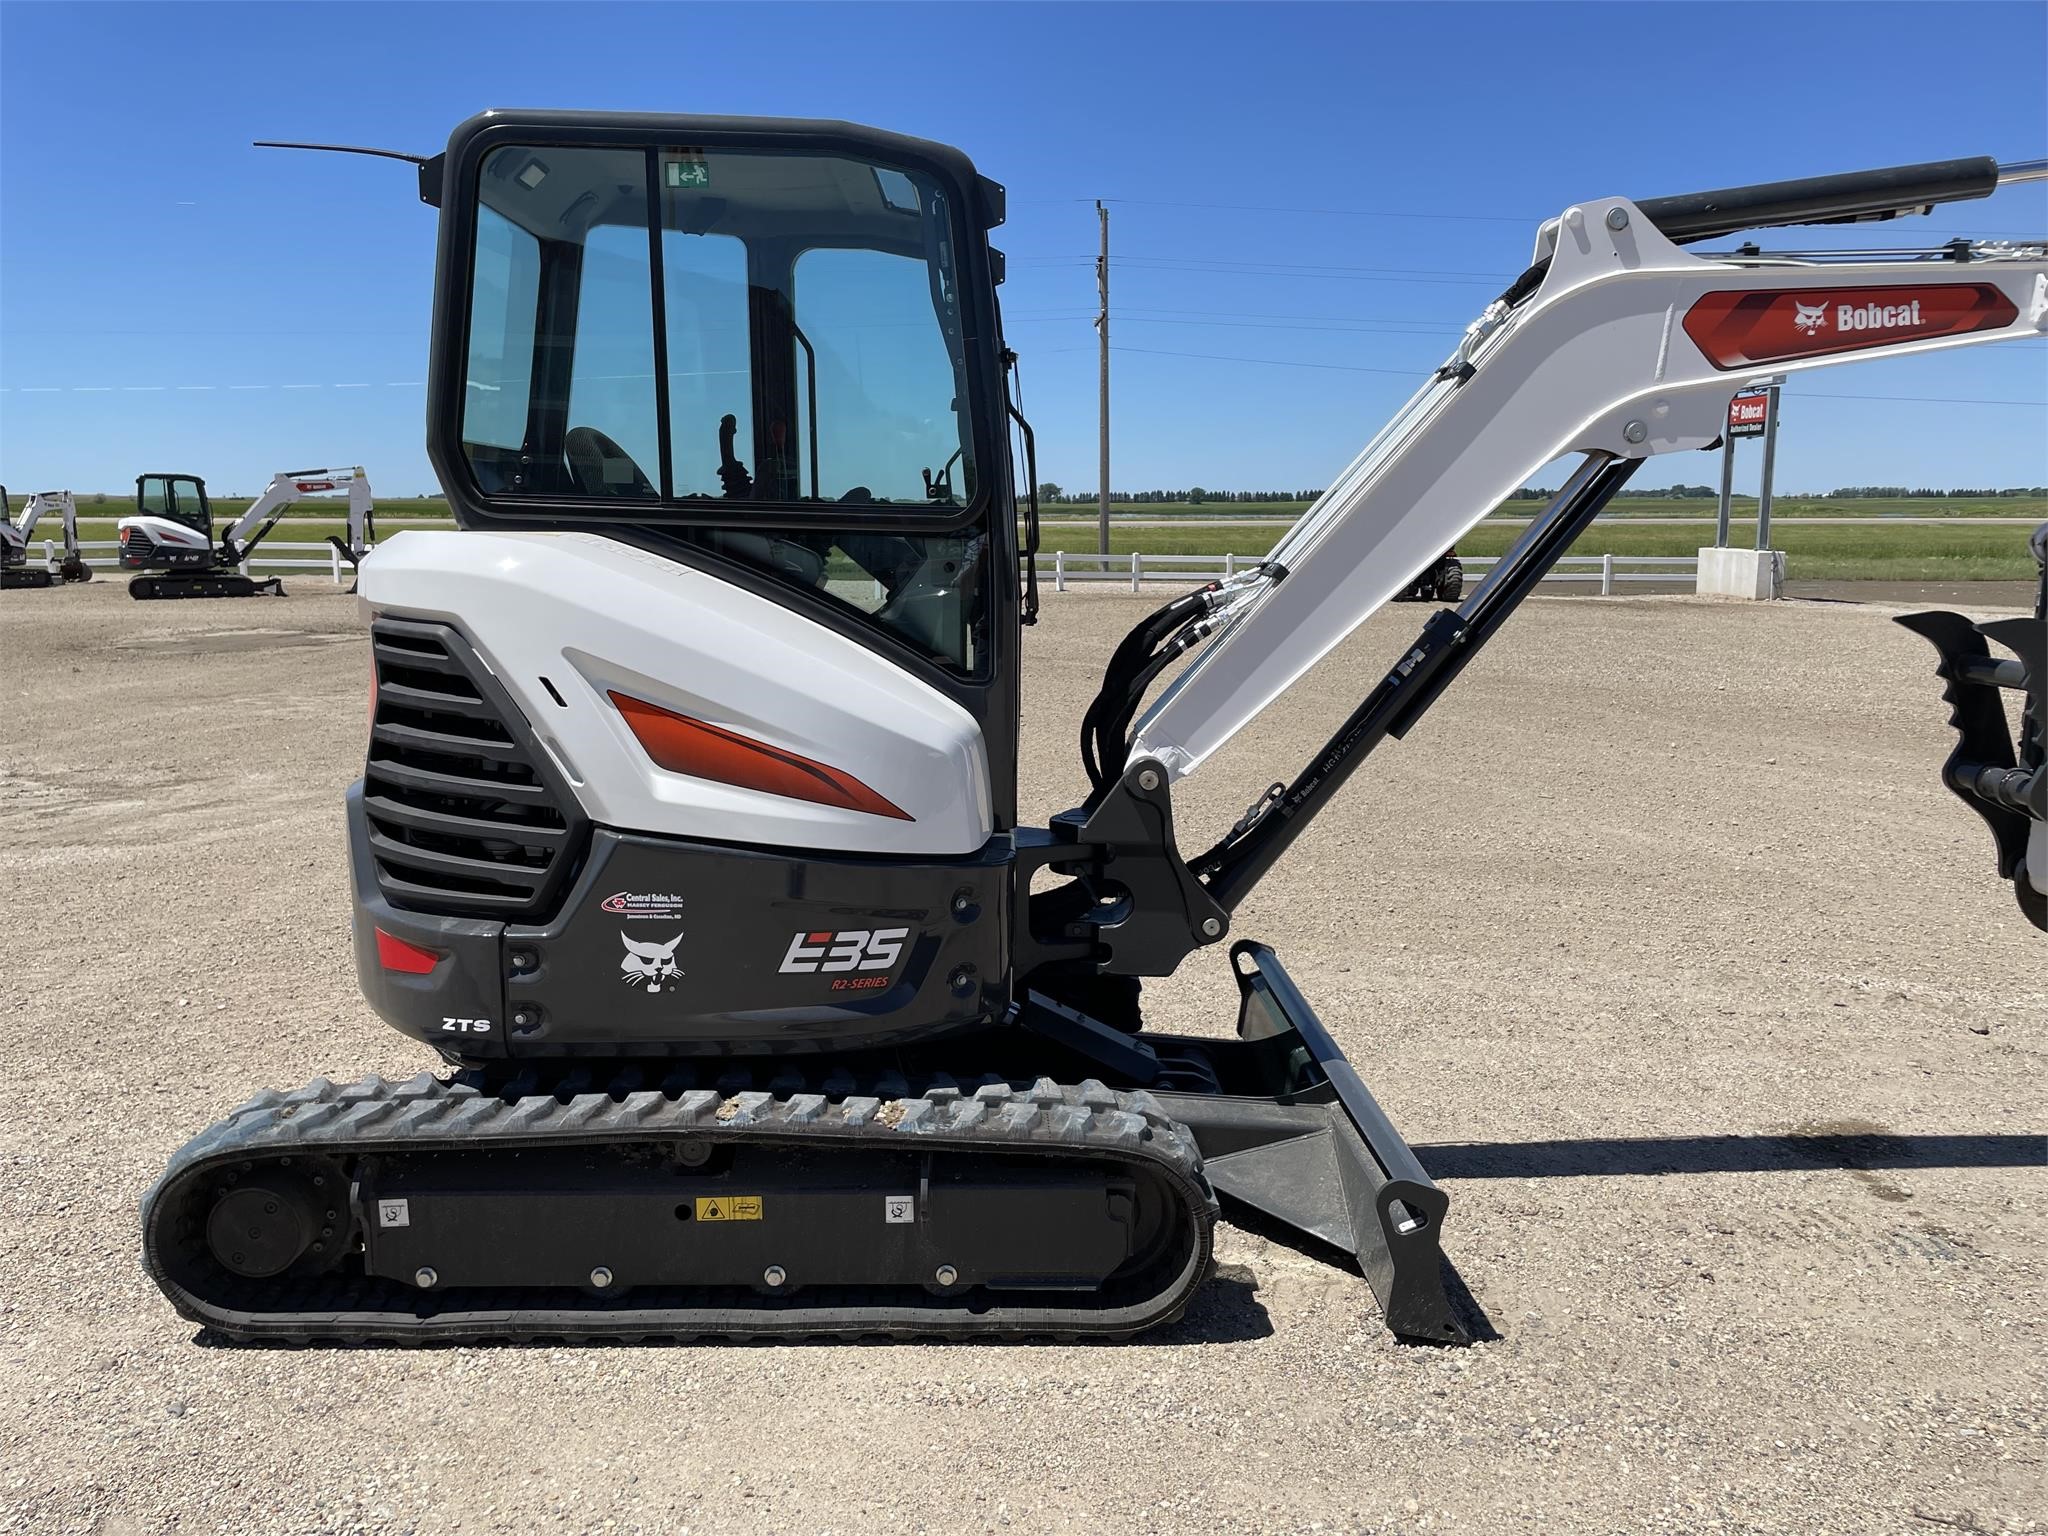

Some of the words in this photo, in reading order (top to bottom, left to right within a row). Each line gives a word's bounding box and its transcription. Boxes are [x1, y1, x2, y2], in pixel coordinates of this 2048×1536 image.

[1837, 300, 1921, 332] Bobcat
[1740, 403, 1764, 420] Bobcat
[626, 893, 651, 902] Central
[651, 893, 670, 903] Sales,
[670, 893, 684, 902] Inc.
[778, 928, 909, 973] E35
[832, 977, 888, 990] R2-SERIES
[442, 1017, 491, 1032] ZTS
